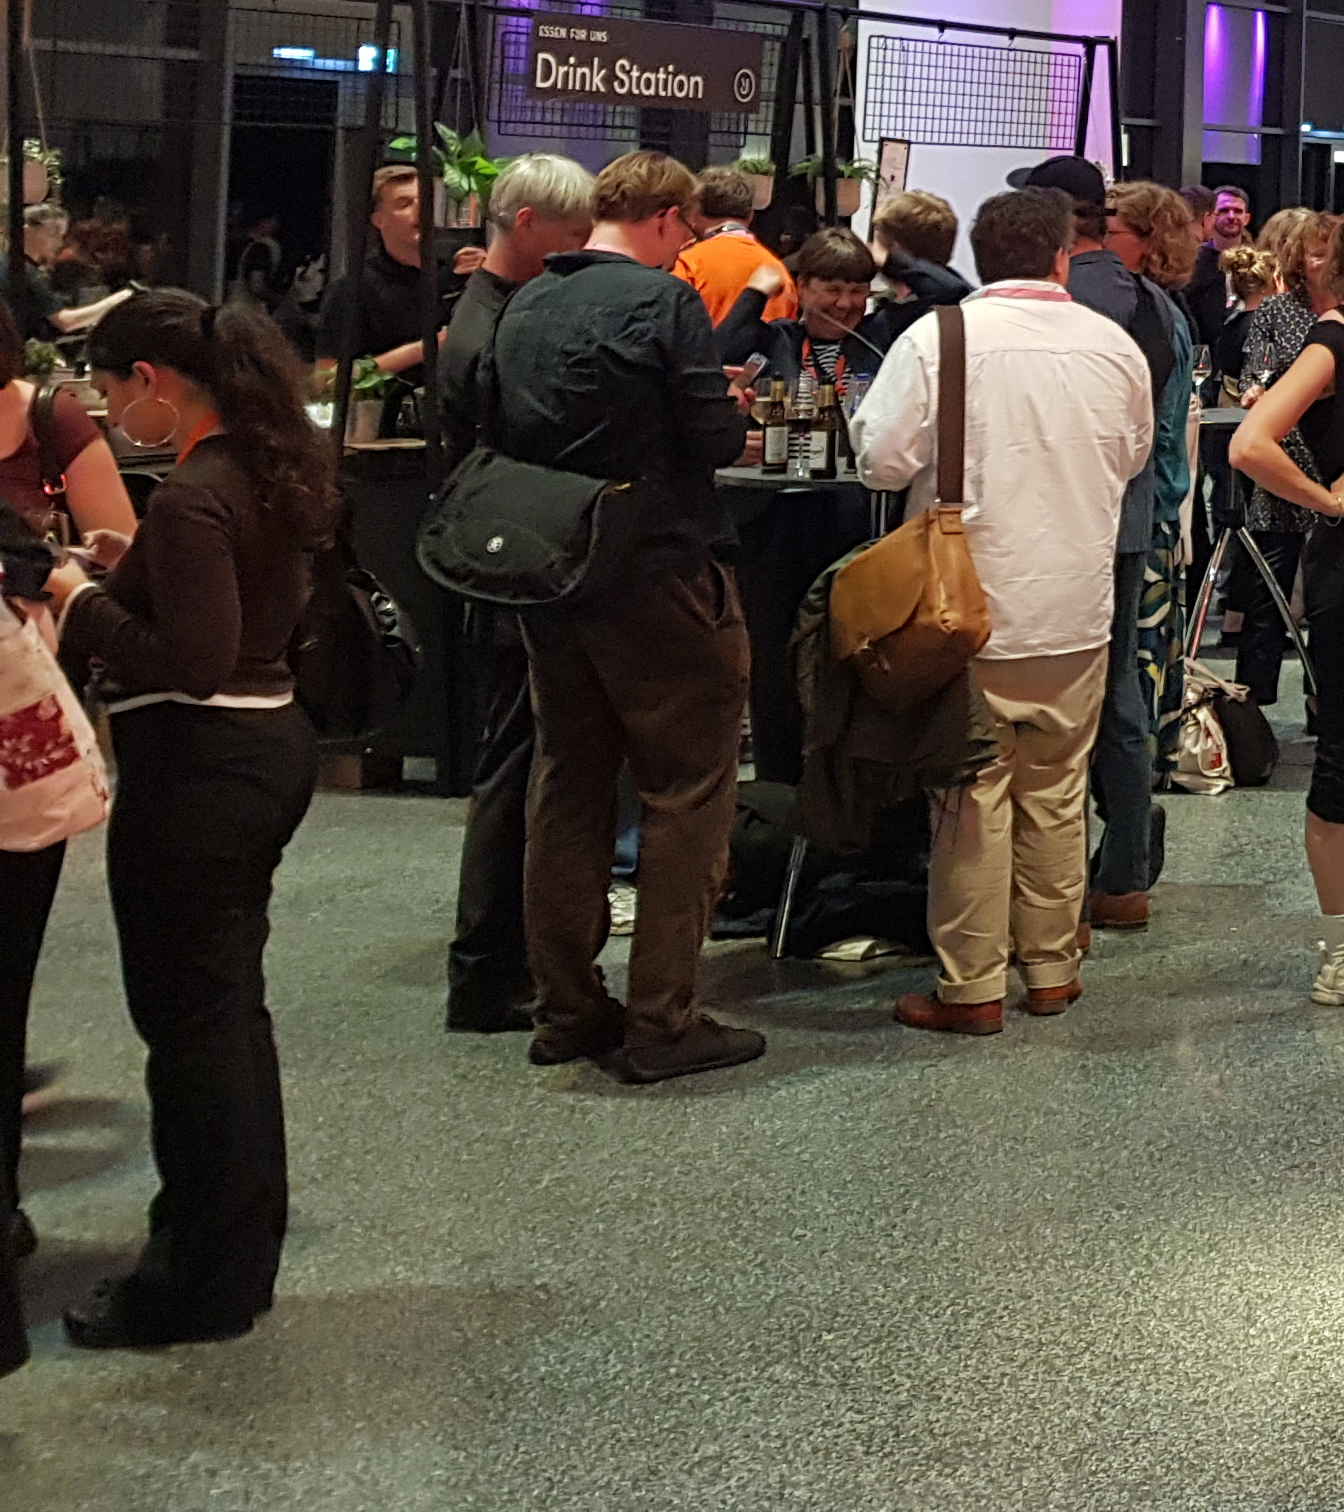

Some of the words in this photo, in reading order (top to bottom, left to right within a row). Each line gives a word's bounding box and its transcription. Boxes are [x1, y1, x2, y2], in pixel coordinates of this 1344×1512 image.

[538, 25, 567, 39] ESSEN
[535, 52, 607, 92] Drink
[613, 58, 704, 99] Station
